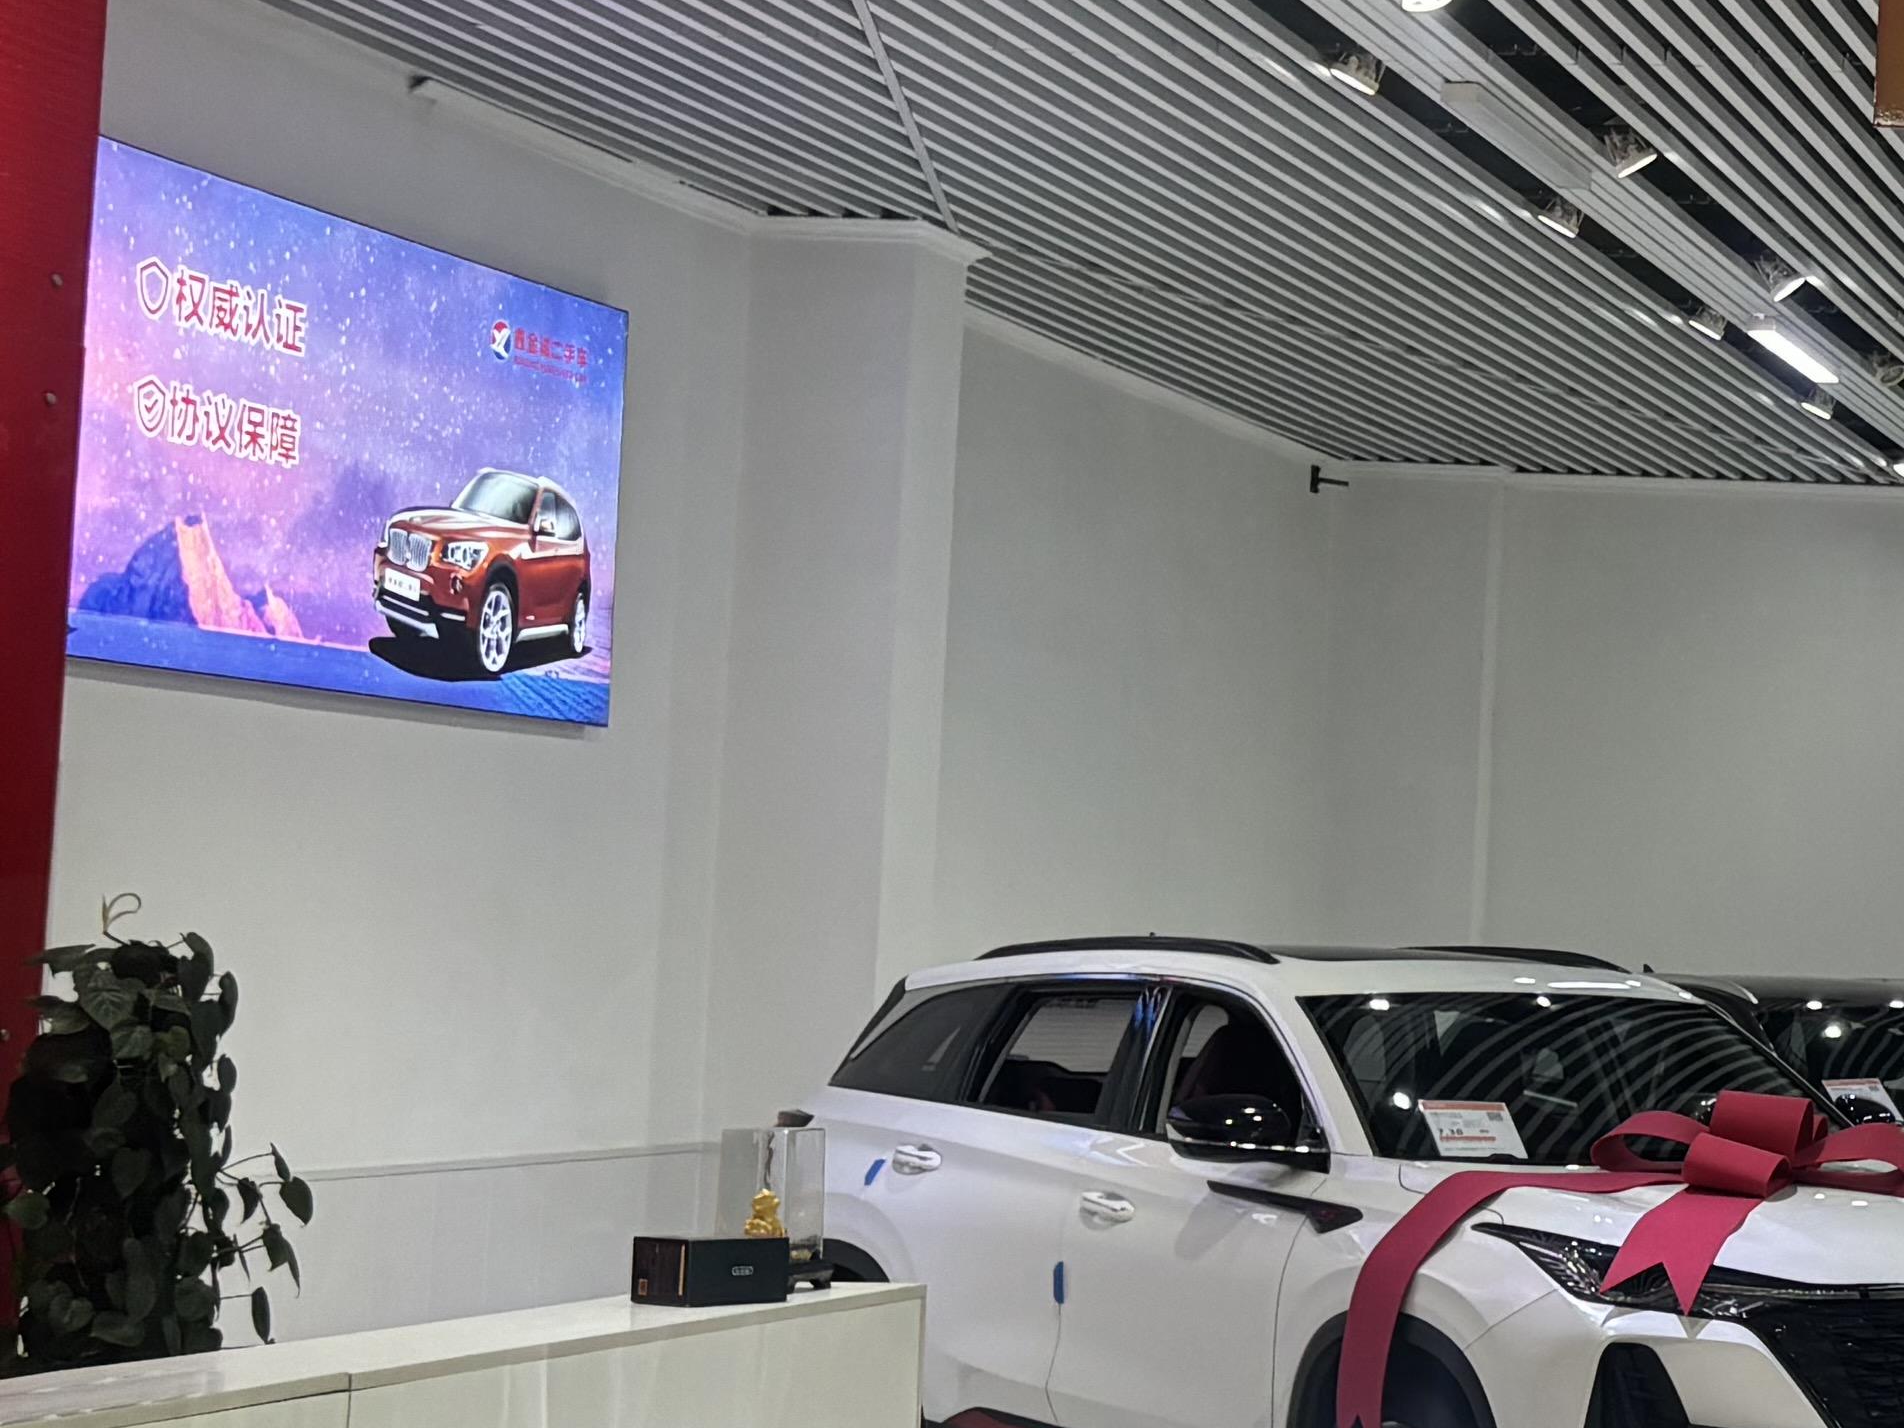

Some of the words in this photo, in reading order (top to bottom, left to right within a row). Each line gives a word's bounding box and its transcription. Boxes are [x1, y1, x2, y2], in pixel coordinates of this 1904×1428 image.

[173, 268, 307, 358] 权威认证
[167, 383, 302, 468] 协议保障
